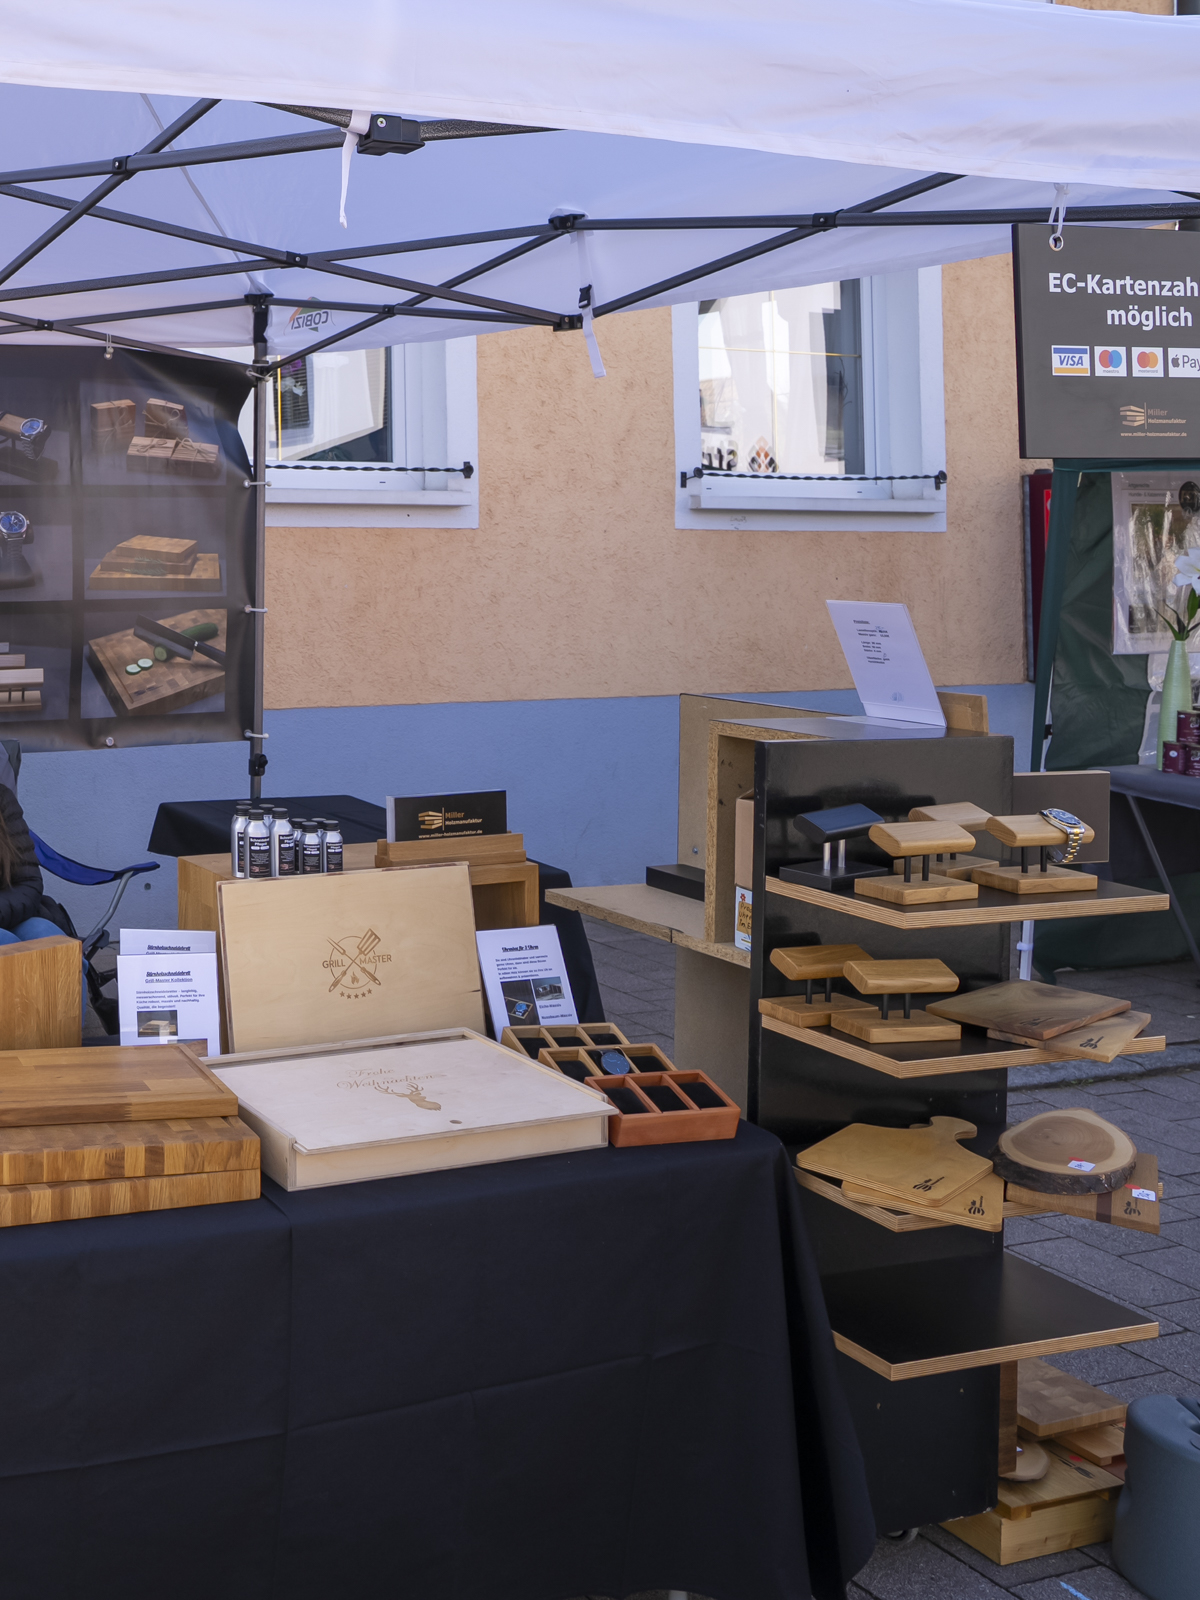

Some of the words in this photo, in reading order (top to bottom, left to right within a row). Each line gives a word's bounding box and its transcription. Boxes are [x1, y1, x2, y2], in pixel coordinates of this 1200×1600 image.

[1107, 305, 1193, 331] möglich
[1058, 355, 1084, 366] VISA
[322, 959, 346, 968] GRILL
[360, 954, 392, 965] MASTER
[346, 1068, 395, 1078] Frohe
